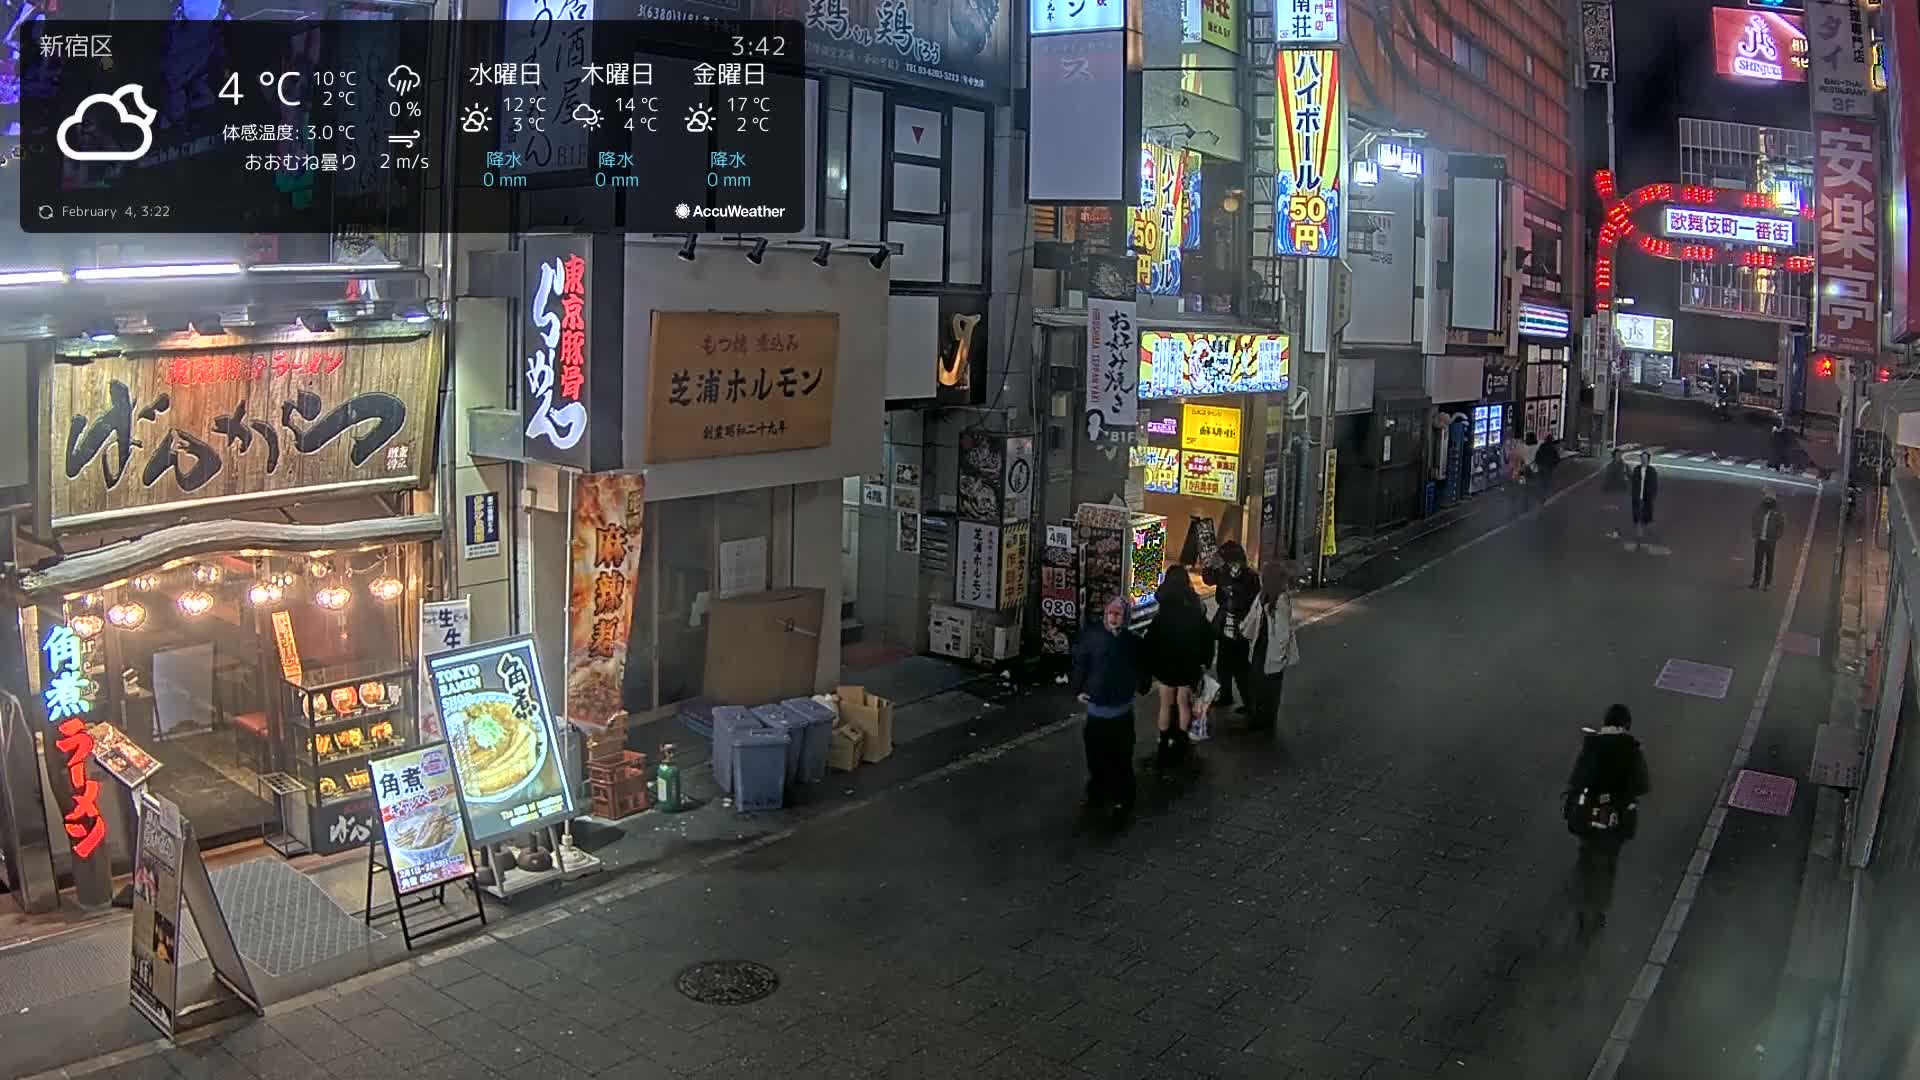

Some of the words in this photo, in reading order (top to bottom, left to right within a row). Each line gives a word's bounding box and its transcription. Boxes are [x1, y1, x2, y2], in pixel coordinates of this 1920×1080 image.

[1296, 55, 1320, 191] ハイボール
[1670, 210, 1790, 244] 歌舞伎町一番街
[1819, 127, 1874, 330] 安楽亭
[561, 254, 585, 401] 東京豚骨
[669, 366, 824, 407] 芝浦ホルモン
[1103, 310, 1136, 414] お好み焼き
[436, 663, 481, 685] TOKYO
[438, 676, 482, 698] RAMEN
[499, 654, 540, 721] 角煮
[379, 765, 425, 799] 角煮
